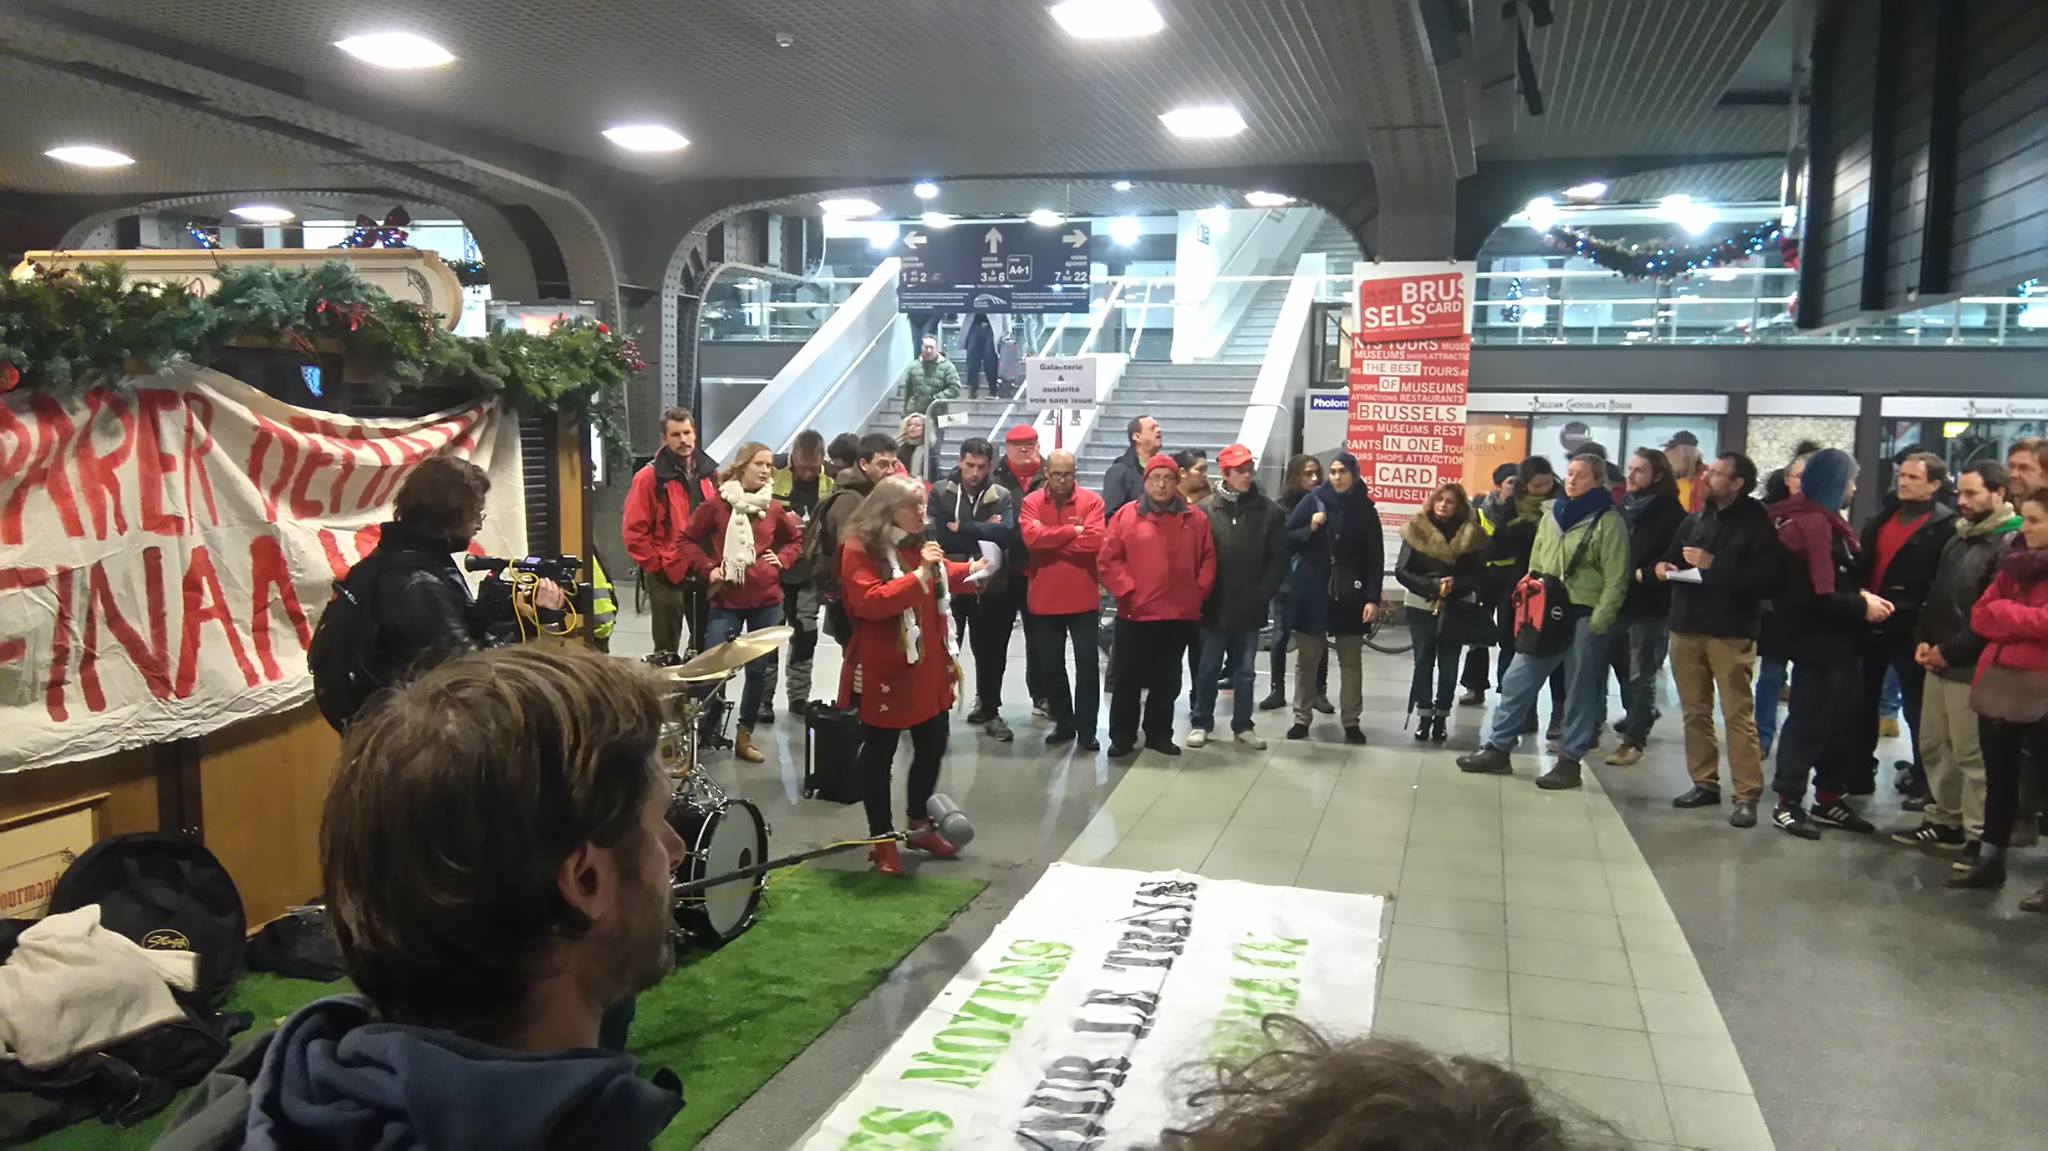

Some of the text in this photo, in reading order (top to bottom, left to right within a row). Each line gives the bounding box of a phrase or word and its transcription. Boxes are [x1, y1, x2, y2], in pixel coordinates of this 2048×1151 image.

[902, 272, 908, 282] 1
[920, 273, 927, 282] 2
[980, 272, 988, 282] 3
[998, 272, 1006, 282] 6
[1054, 271, 1062, 281] 7
[1074, 271, 1088, 282] 22
[1364, 304, 1427, 328] SELS
[1426, 302, 1462, 314] CARD
[1354, 350, 1406, 360] MUSEUMS
[1366, 363, 1387, 373] THE
[1390, 363, 1418, 374] BEST
[1422, 366, 1460, 377] TOURS
[1352, 379, 1464, 394] SHOPS OF MUSEUMS
[1351, 393, 1464, 403] ATTRACTIONS RESTAURANTS
[1359, 404, 1457, 421] BRUSSELS
[1376, 424, 1430, 434] MUSEUMS
[1433, 425, 1465, 437] REST
[1385, 437, 1401, 449] IN
[1407, 438, 1440, 452] ONE
[1444, 445, 1463, 454] TOU
[1375, 454, 1403, 462] SHOPS
[1378, 466, 1433, 485] CARD
